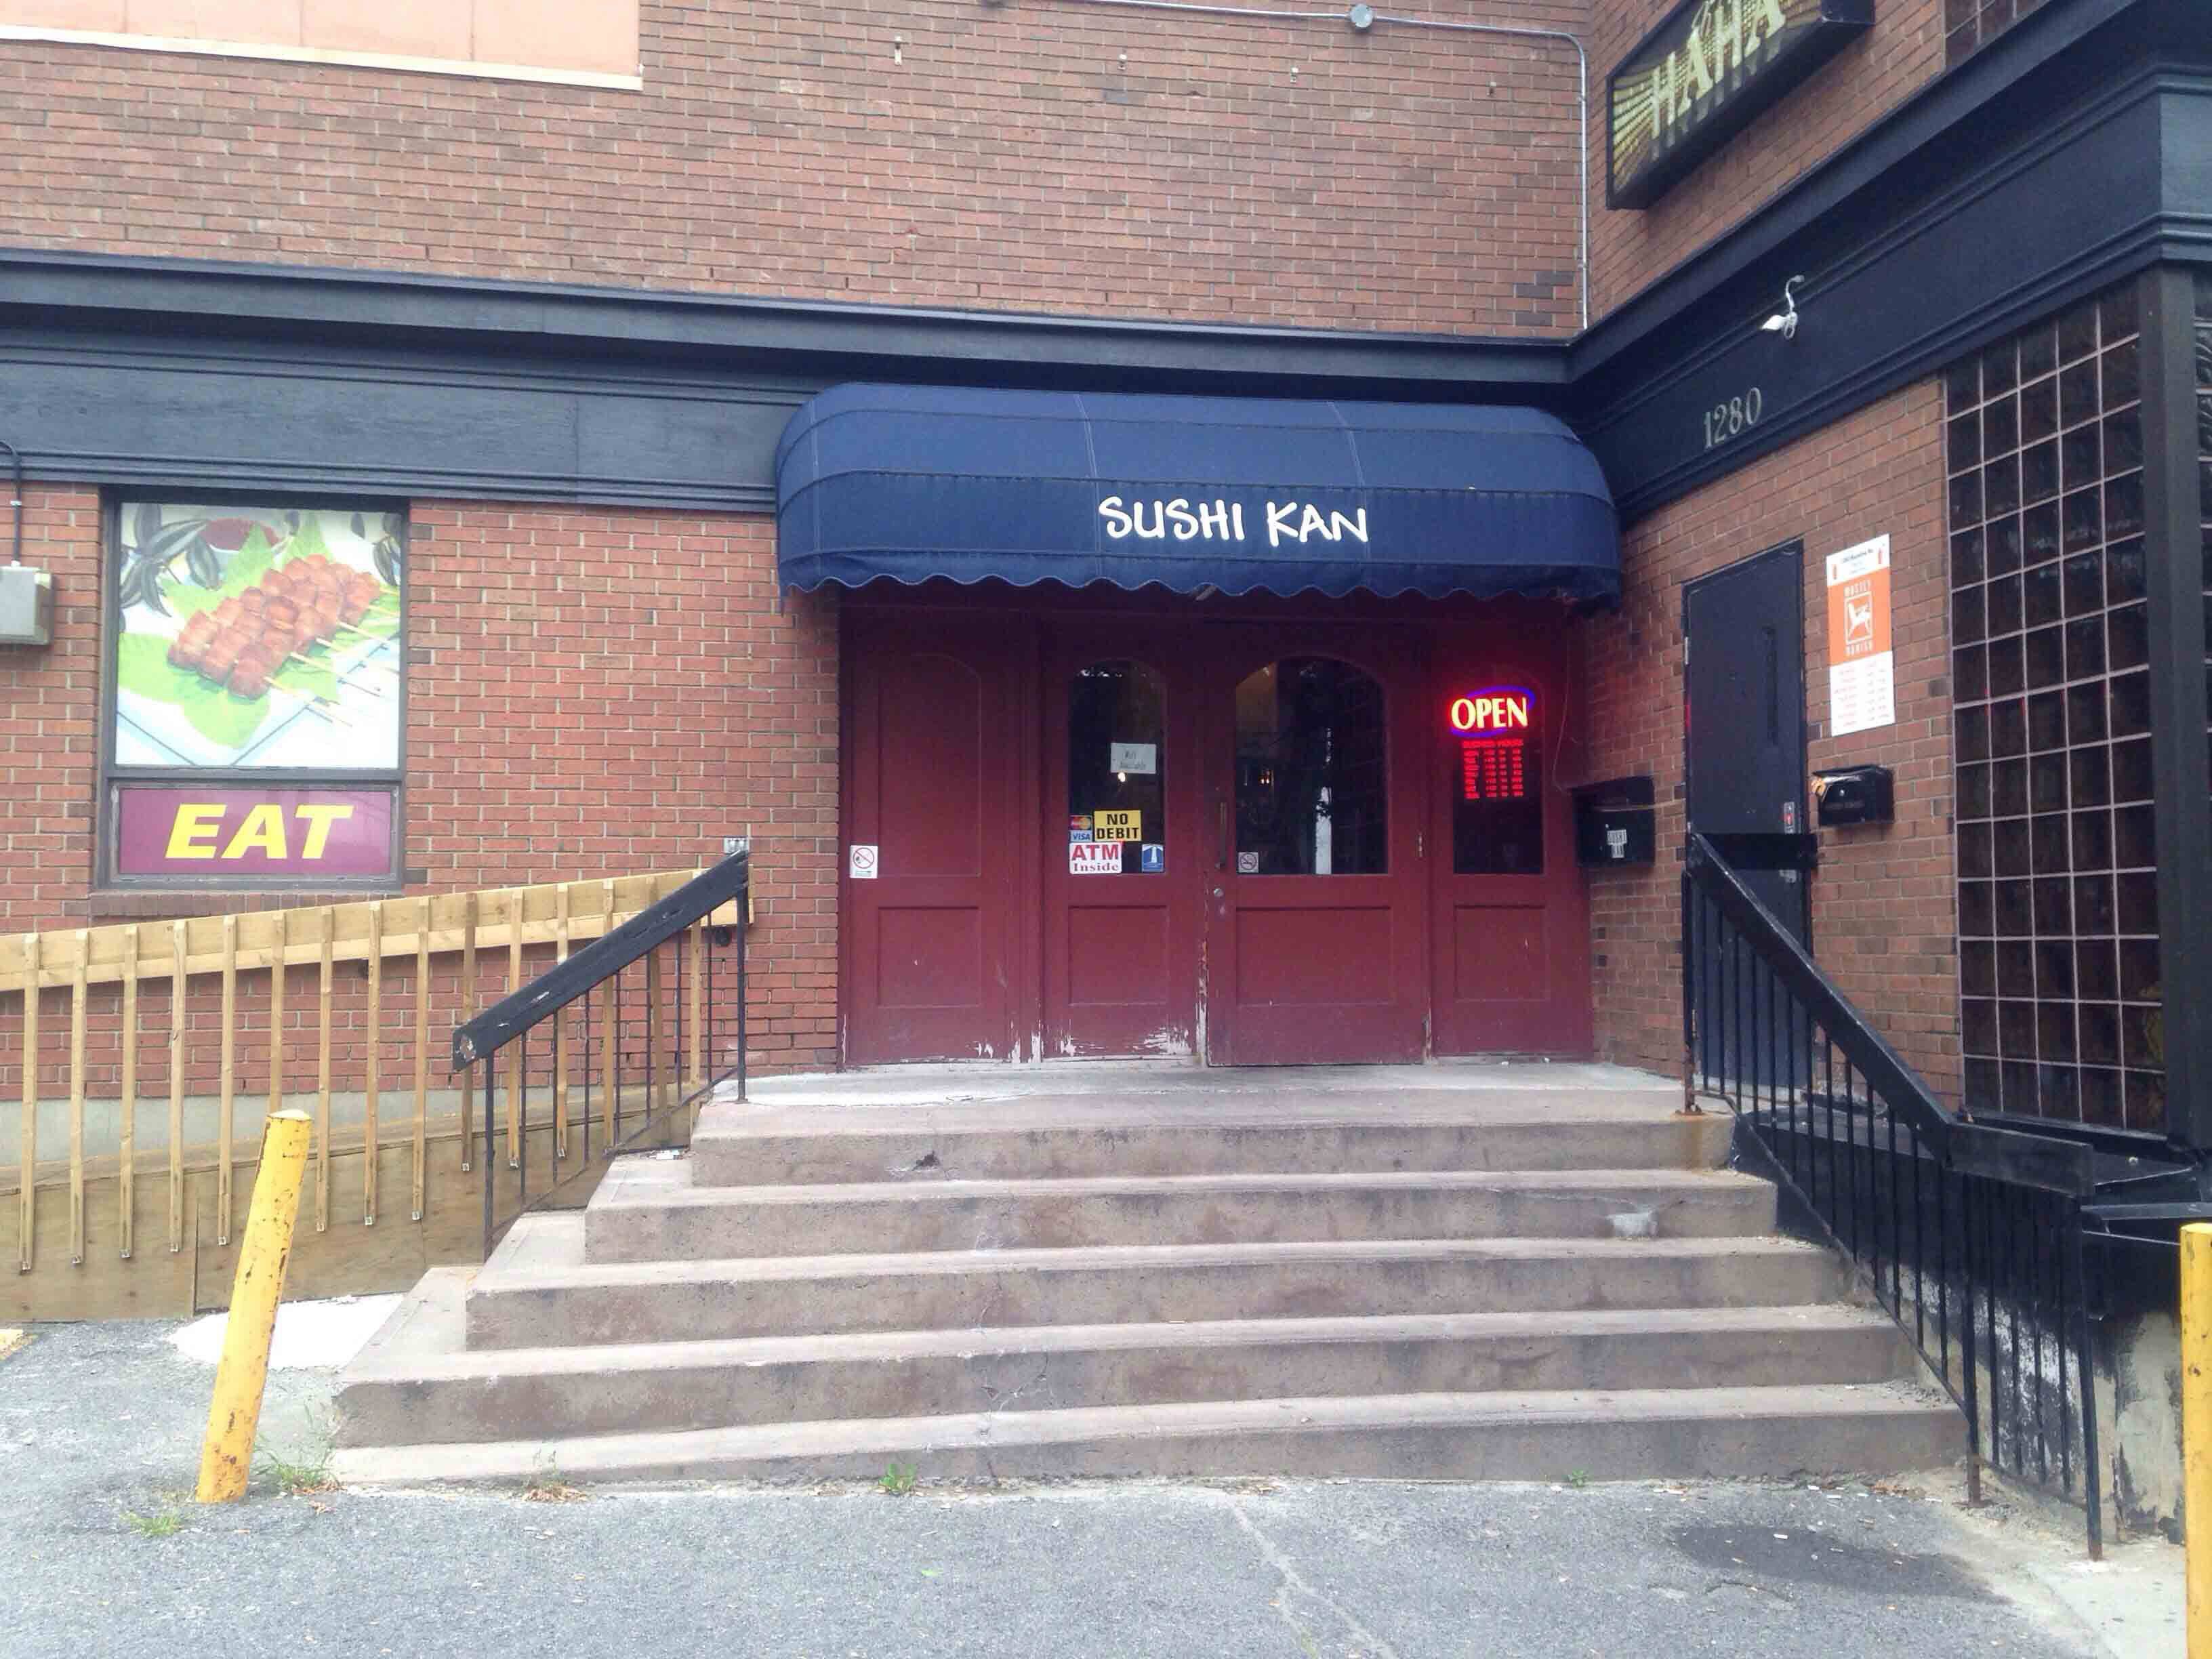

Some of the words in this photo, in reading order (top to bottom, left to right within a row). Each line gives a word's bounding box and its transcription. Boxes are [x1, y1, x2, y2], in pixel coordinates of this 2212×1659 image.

[1703, 387, 1762, 450] 1280
[1099, 495, 1245, 540] SUSHI
[1266, 501, 1368, 547] KAN
[1451, 697, 1528, 730] OPEN
[1106, 813, 1128, 825] NO
[164, 803, 354, 859] EAT
[1073, 832, 1090, 841] VISA
[1096, 827, 1139, 840] DEBIT
[1071, 844, 1119, 861] ATM
[1073, 862, 1119, 872] Inside
